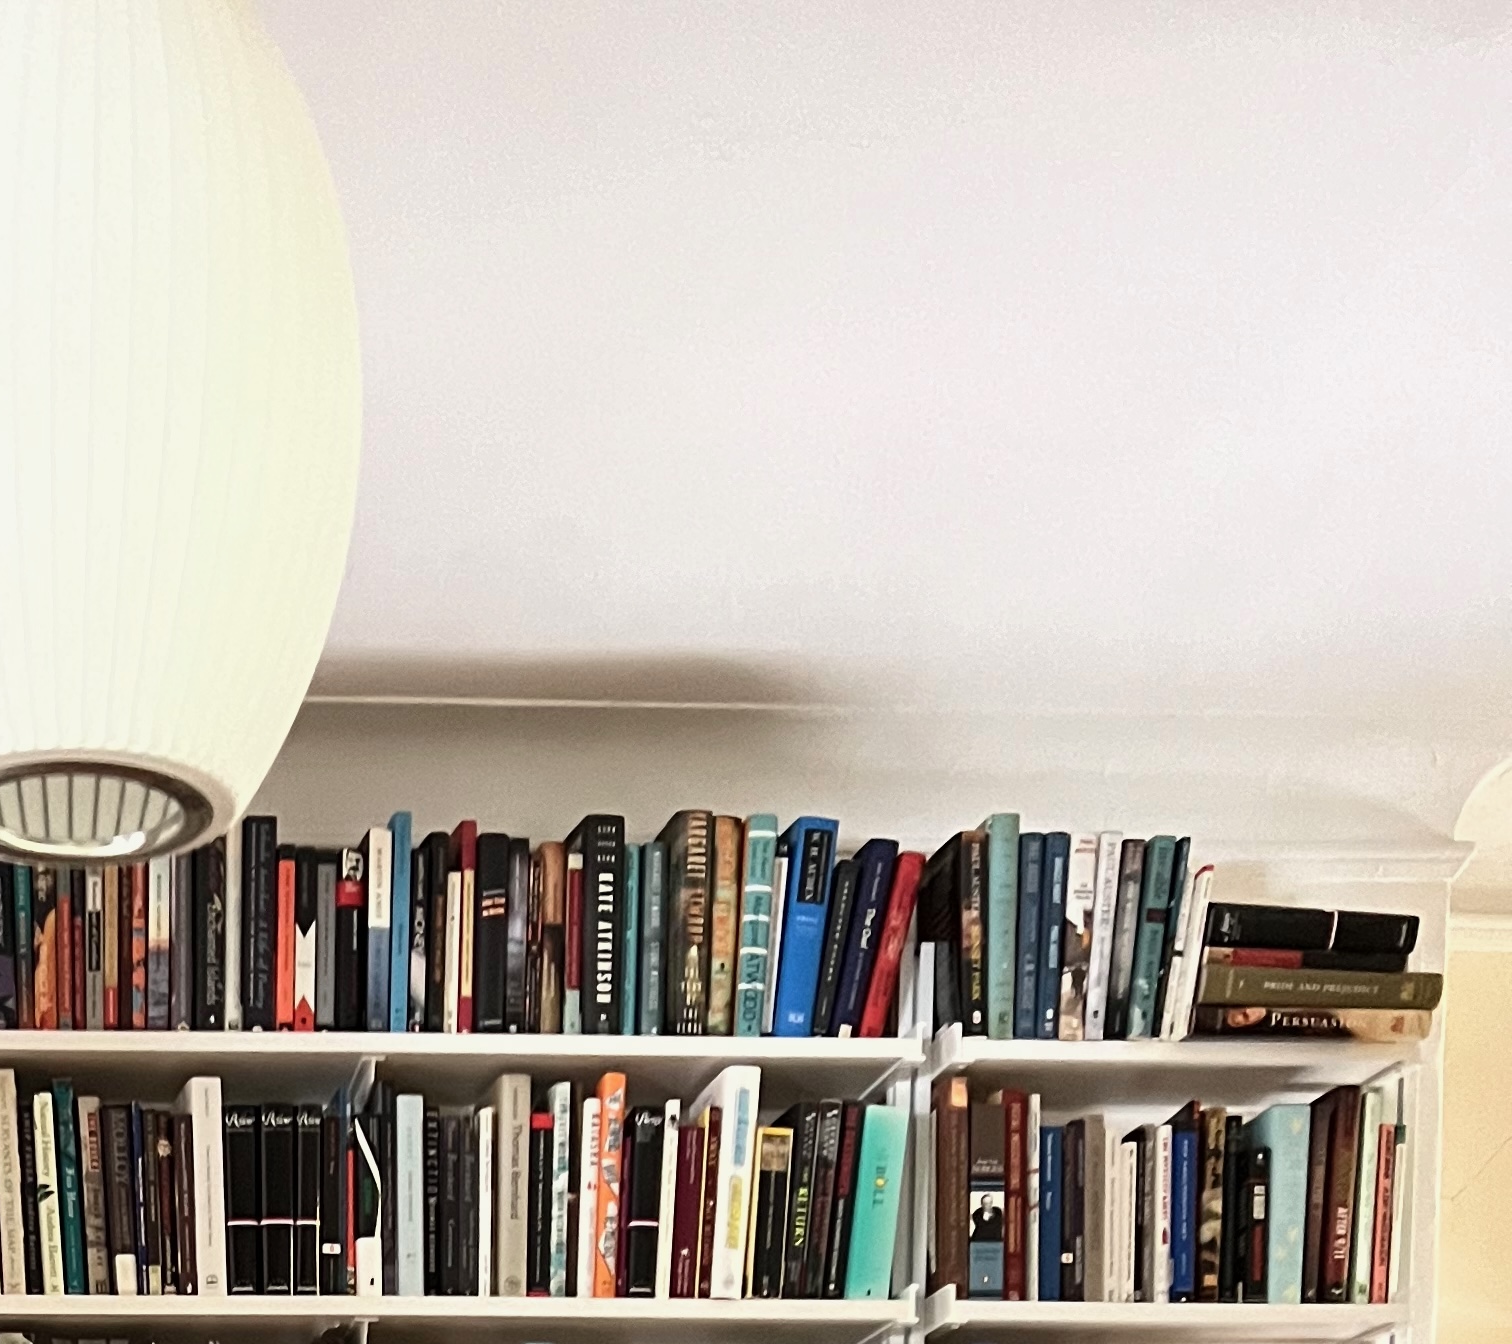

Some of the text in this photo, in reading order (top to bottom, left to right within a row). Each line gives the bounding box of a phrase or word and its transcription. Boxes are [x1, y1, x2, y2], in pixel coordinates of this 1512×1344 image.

[596, 873, 614, 1004] KATE ATKINSON
[1296, 982, 1320, 993] AND
[510, 1125, 523, 1220] Thomas Bernhard
